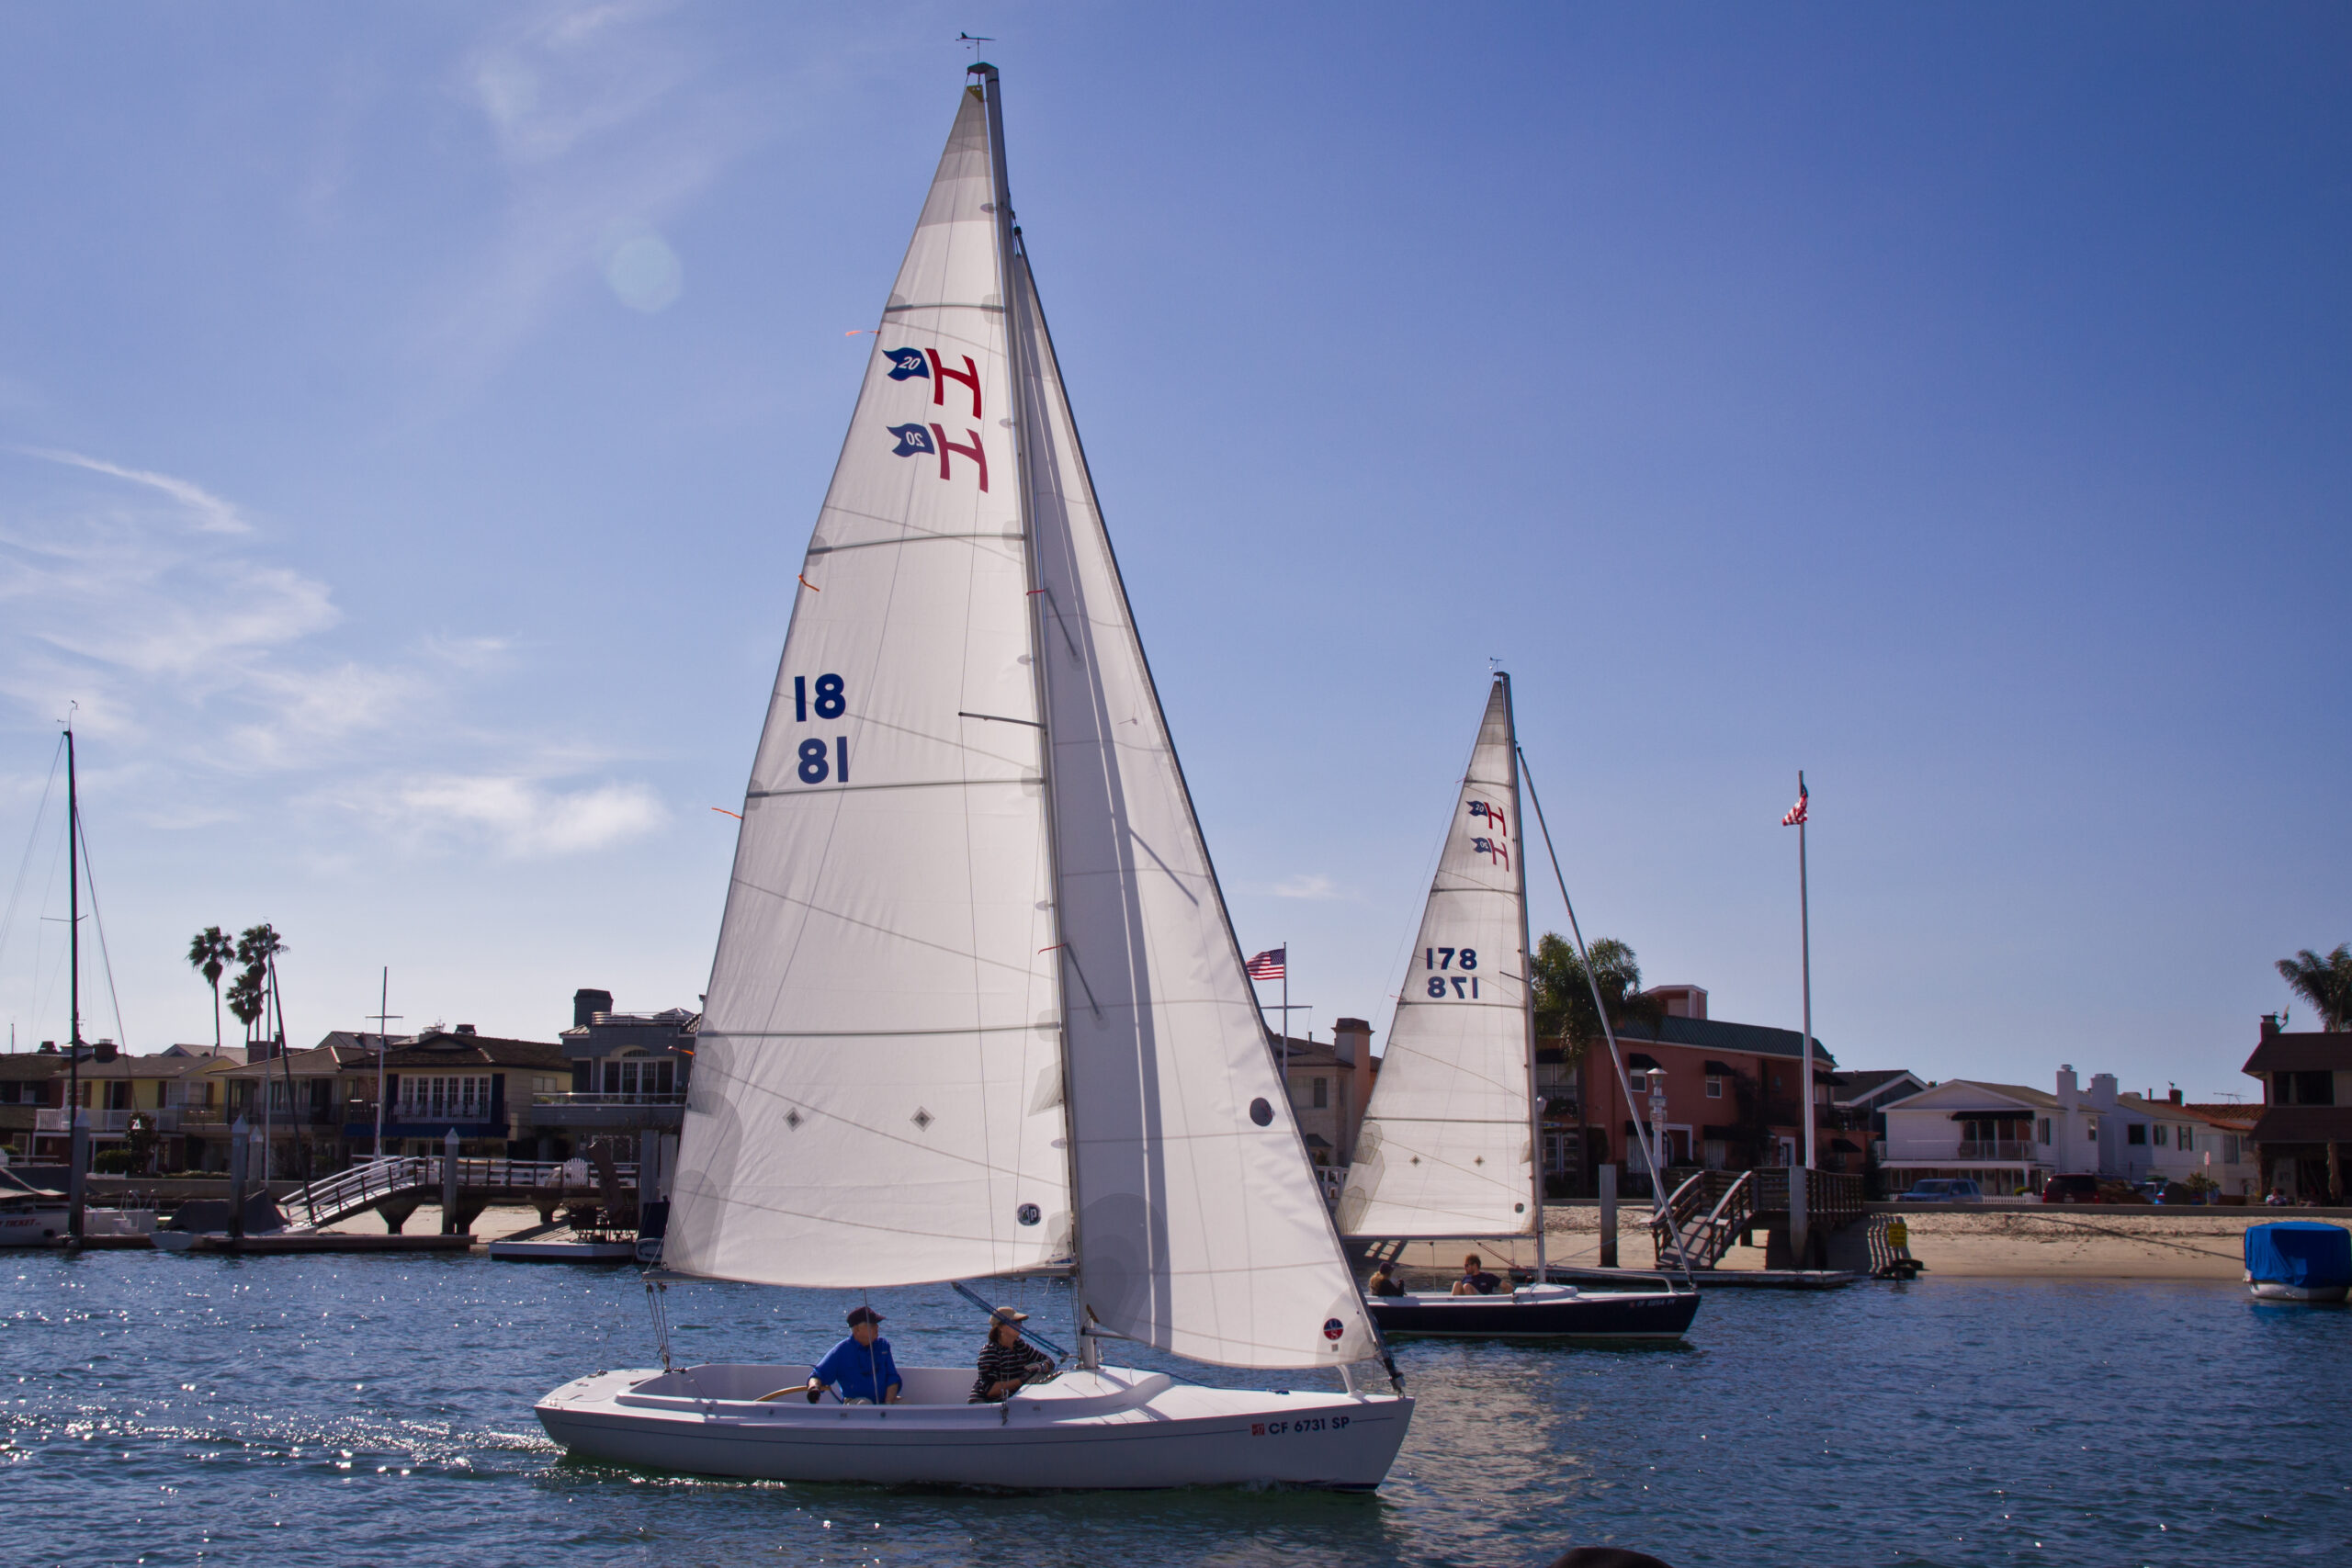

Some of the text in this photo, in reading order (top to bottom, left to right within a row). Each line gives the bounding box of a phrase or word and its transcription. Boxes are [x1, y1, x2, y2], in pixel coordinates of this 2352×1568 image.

[898, 347, 982, 420] 20 H
[794, 672, 846, 723] 18
[1426, 947, 1477, 970] 178
[1268, 1421, 1288, 1435] CF
[1294, 1418, 1326, 1433] 6731
[1331, 1416, 1350, 1429] SP
